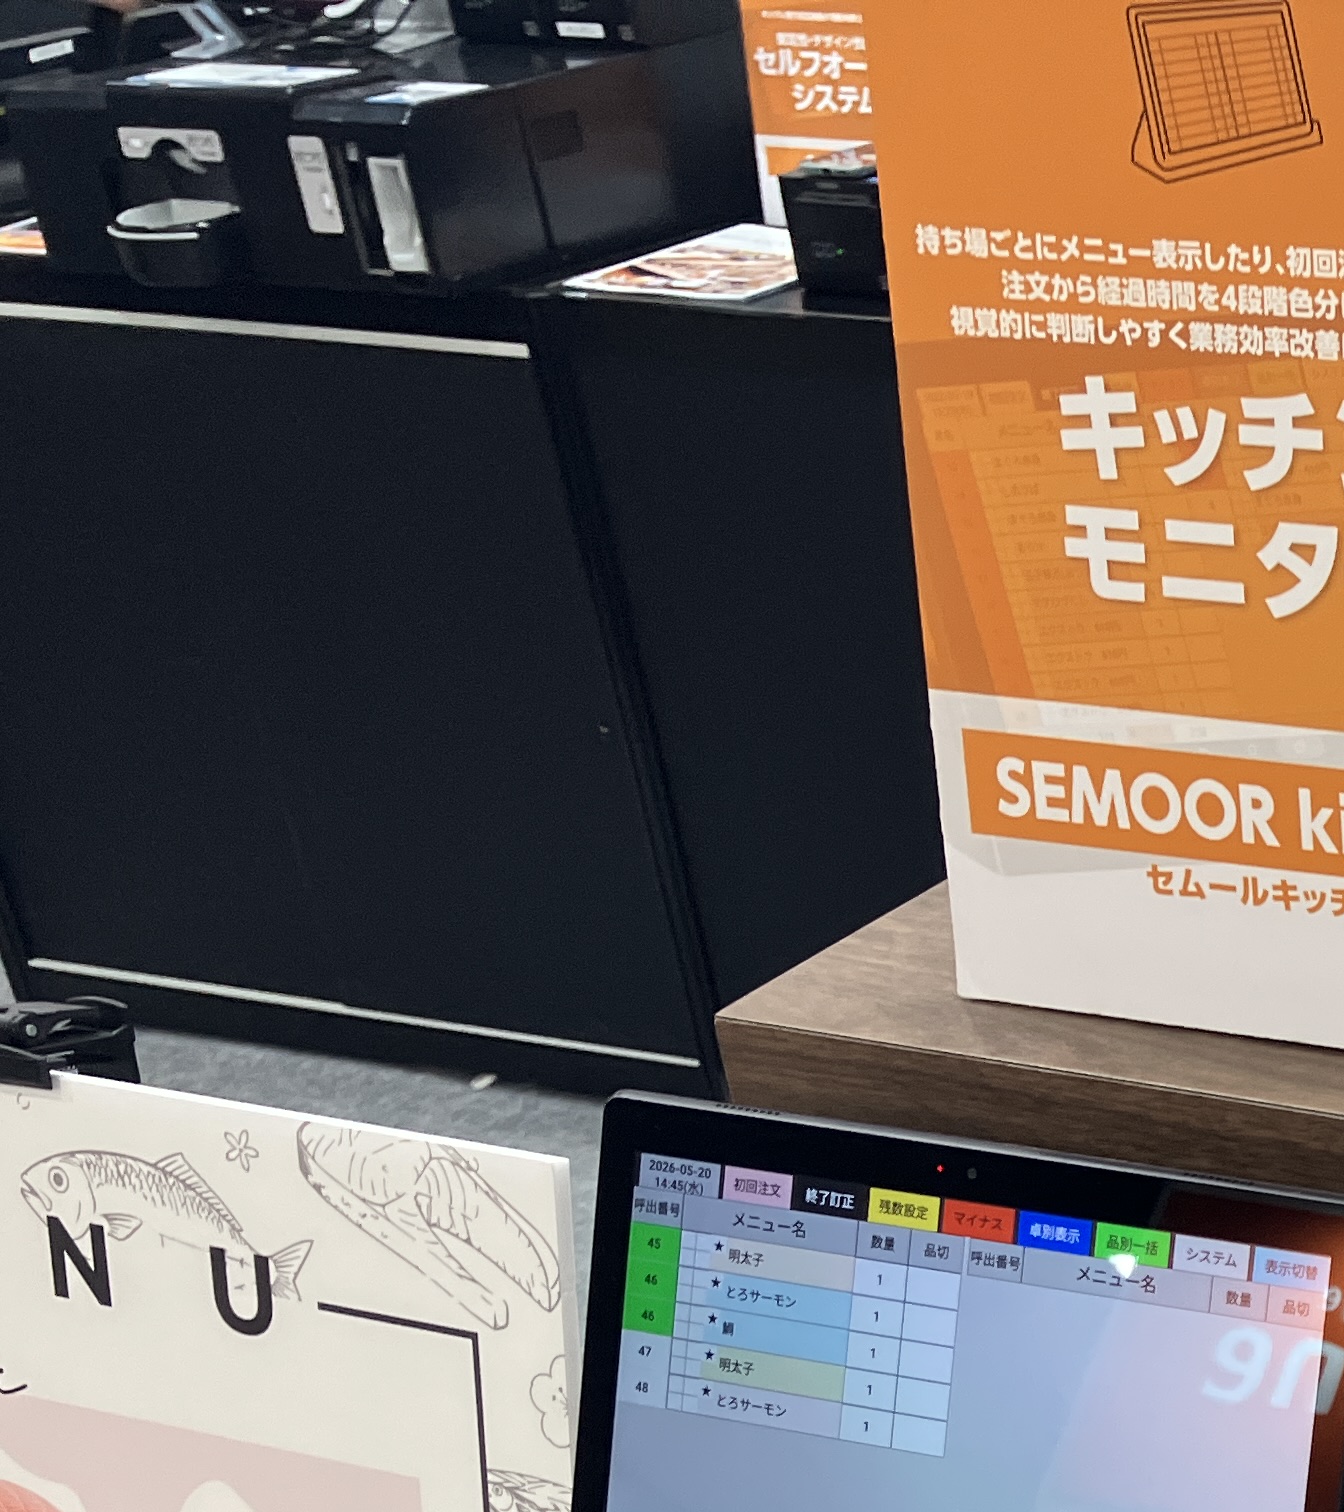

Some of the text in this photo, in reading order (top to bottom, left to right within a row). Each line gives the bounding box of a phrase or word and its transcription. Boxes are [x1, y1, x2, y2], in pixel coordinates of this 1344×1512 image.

[995, 755, 1281, 849] SEMOOR
[649, 1159, 712, 1179] 2026-05-20
[734, 1178, 781, 1198] 初回注文
[634, 1198, 680, 1218] 呼出番号
[733, 1213, 806, 1239] メニュー名
[953, 1211, 1003, 1231] マイナス
[647, 1238, 661, 1250] 45
[728, 1248, 764, 1267] 明太子
[871, 1235, 895, 1252] 数量
[924, 1243, 950, 1260] 品切
[970, 1251, 1021, 1272] 呼出番号
[1186, 1247, 1238, 1268] システム
[644, 1273, 658, 1286] 46
[726, 1286, 797, 1307] とろサーモン
[1076, 1266, 1157, 1295] メニュー名
[1225, 1290, 1252, 1308] 数量
[1282, 1299, 1310, 1317] 品切
[641, 1309, 655, 1322] 46
[638, 1345, 652, 1358] 47
[719, 1357, 755, 1376] 明太子
[635, 1381, 649, 1394] 48
[716, 1394, 787, 1417] とろサーモン
